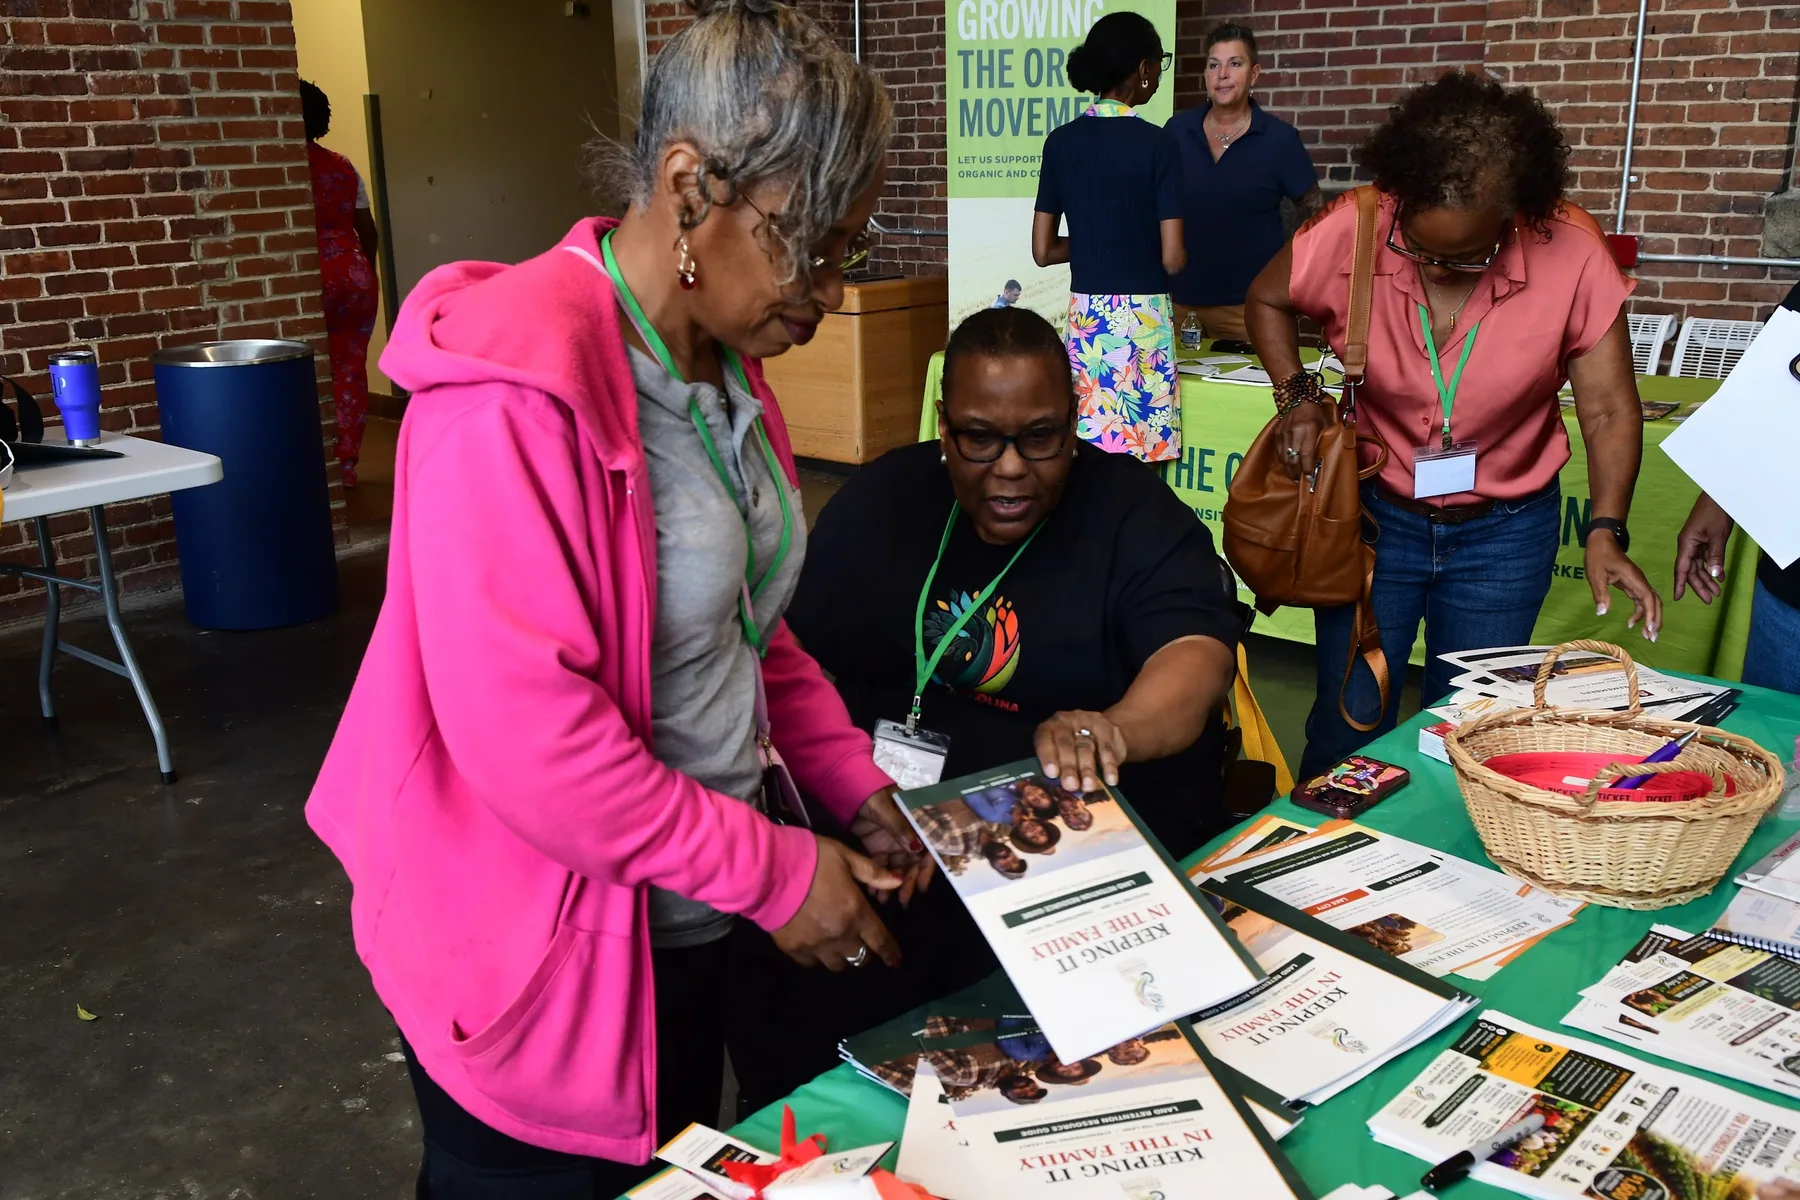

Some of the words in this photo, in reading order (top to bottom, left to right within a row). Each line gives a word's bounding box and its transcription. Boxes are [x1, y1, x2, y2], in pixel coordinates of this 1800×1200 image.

[957, 0, 1104, 40] GROWING
[957, 49, 1014, 89] THE
[958, 156, 976, 164] LET
[979, 156, 993, 164] US
[995, 155, 1043, 164] SUPPORT
[958, 170, 1003, 178] ORGANIC
[1006, 170, 1028, 178] AND
[1598, 792, 1631, 802] TICKET
[1384, 869, 1423, 884] GREENVILLE
[1314, 902, 1333, 910] CITY
[1328, 896, 1349, 905] LAKE
[1146, 902, 1171, 918] IN
[1104, 910, 1147, 933] THE
[1486, 920, 1530, 940] KEEPING
[1029, 925, 1103, 959] FAMILY
[1081, 923, 1170, 962] KEEPING
[1461, 941, 1479, 949] IN
[1440, 946, 1467, 958] THE
[1052, 954, 1078, 973] IT
[1279, 963, 1298, 976] LAND
[1247, 974, 1282, 995] RETENTION
[1315, 970, 1342, 987] IN
[1218, 992, 1250, 1009] RESOURCE
[1279, 987, 1321, 1011] THE
[1267, 986, 1349, 1036] KEEPING
[1217, 1008, 1283, 1042] FAMILY
[1245, 1032, 1271, 1046] IT
[1099, 1109, 1152, 1123] RETENTION
[1152, 1105, 1179, 1114] LAND
[1019, 1125, 1049, 1136] GUIDE
[1049, 1116, 1099, 1130] RESOURCE
[1181, 1127, 1214, 1143] IN
[1730, 1119, 1772, 1158] STRONGER
[1119, 1134, 1179, 1154] THE
[1751, 1125, 1796, 1168] BUILDING
[1017, 1144, 1114, 1170] FAMILY
[1079, 1146, 1204, 1177] KEEPING
[1043, 1167, 1072, 1184] IT
